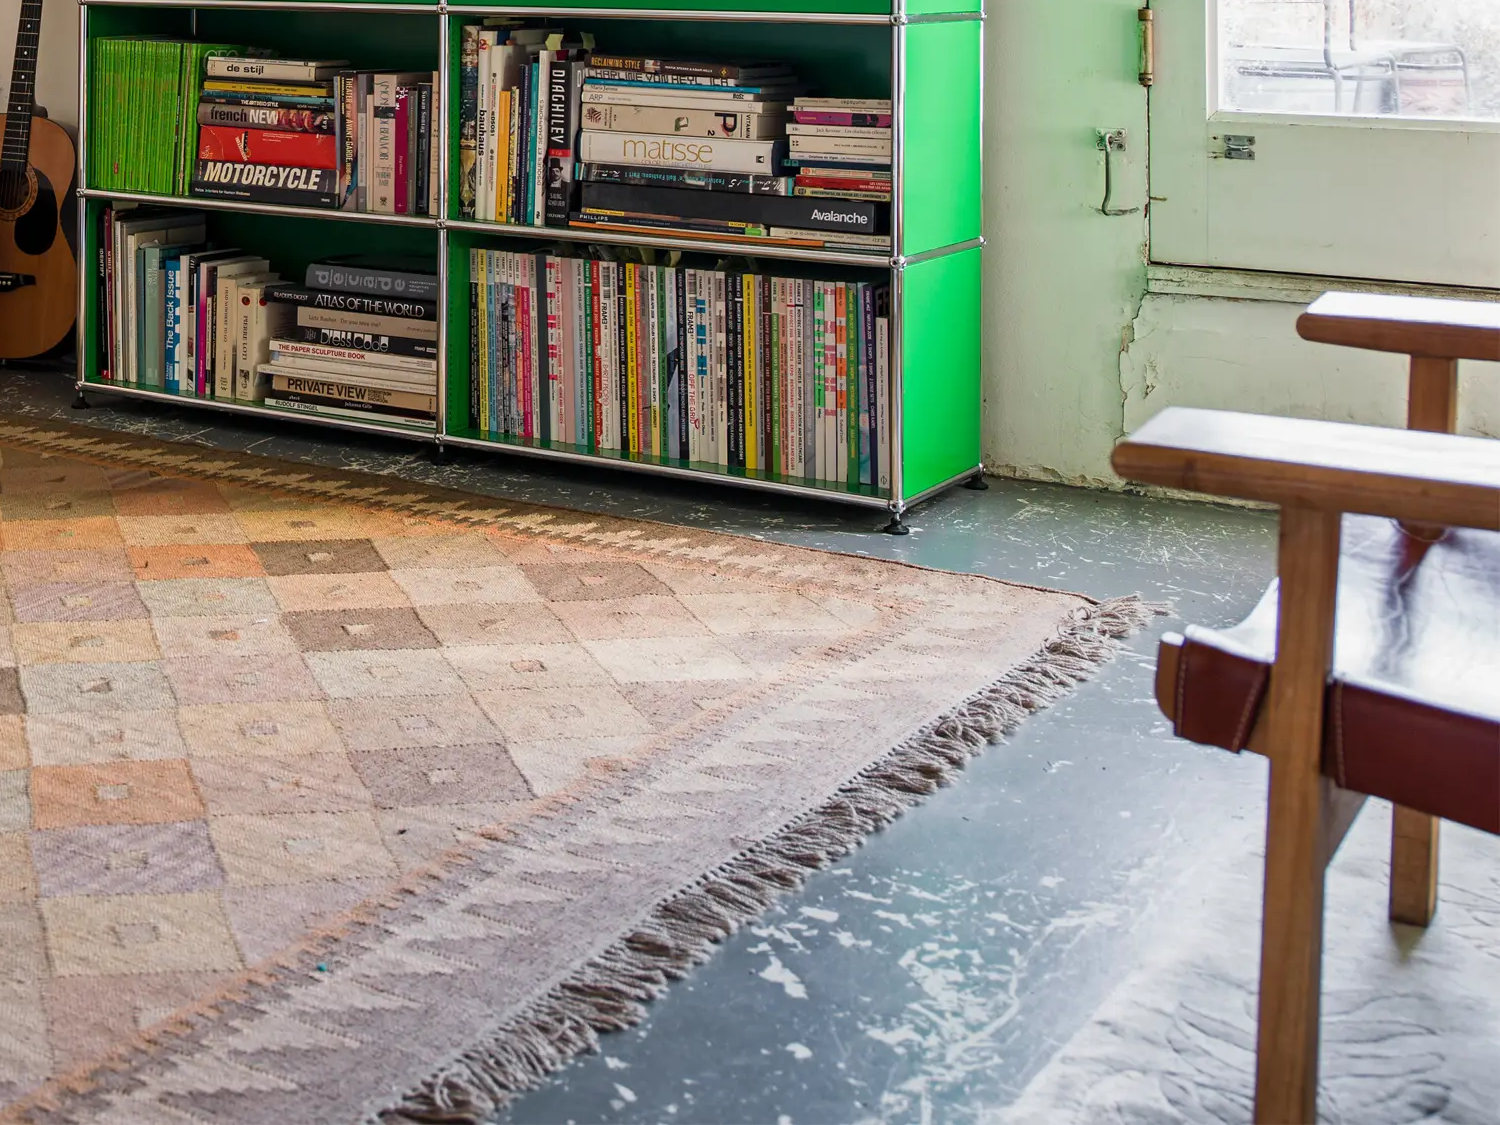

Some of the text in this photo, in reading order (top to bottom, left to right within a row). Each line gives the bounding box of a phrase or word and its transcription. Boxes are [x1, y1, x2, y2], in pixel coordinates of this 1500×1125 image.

[226, 64, 264, 75] de stijl
[591, 57, 641, 69] RECLAIMING STYLE
[551, 69, 565, 143] DIAGHILEV
[589, 93, 603, 101] ARP
[210, 106, 247, 122] french
[249, 109, 279, 125] NEW
[345, 77, 354, 163] THEATER AVANT-GARDE,
[478, 109, 487, 156] bauhaus
[379, 127, 389, 160] BEAUVOIR
[623, 139, 713, 163] matisse
[203, 161, 321, 190] MOTORCYCLE
[579, 213, 609, 221] PHILLIPS
[811, 209, 868, 224] Avalanche
[314, 294, 424, 317] ATLAS OF THE WORLD
[166, 330, 174, 349] The
[321, 329, 389, 353] Dress Code
[278, 343, 366, 360] THE PAPER SCULPTURE BOOK
[288, 378, 367, 399] PRIVATE VIEW
[275, 400, 319, 411] RUDOLF STINGEL
